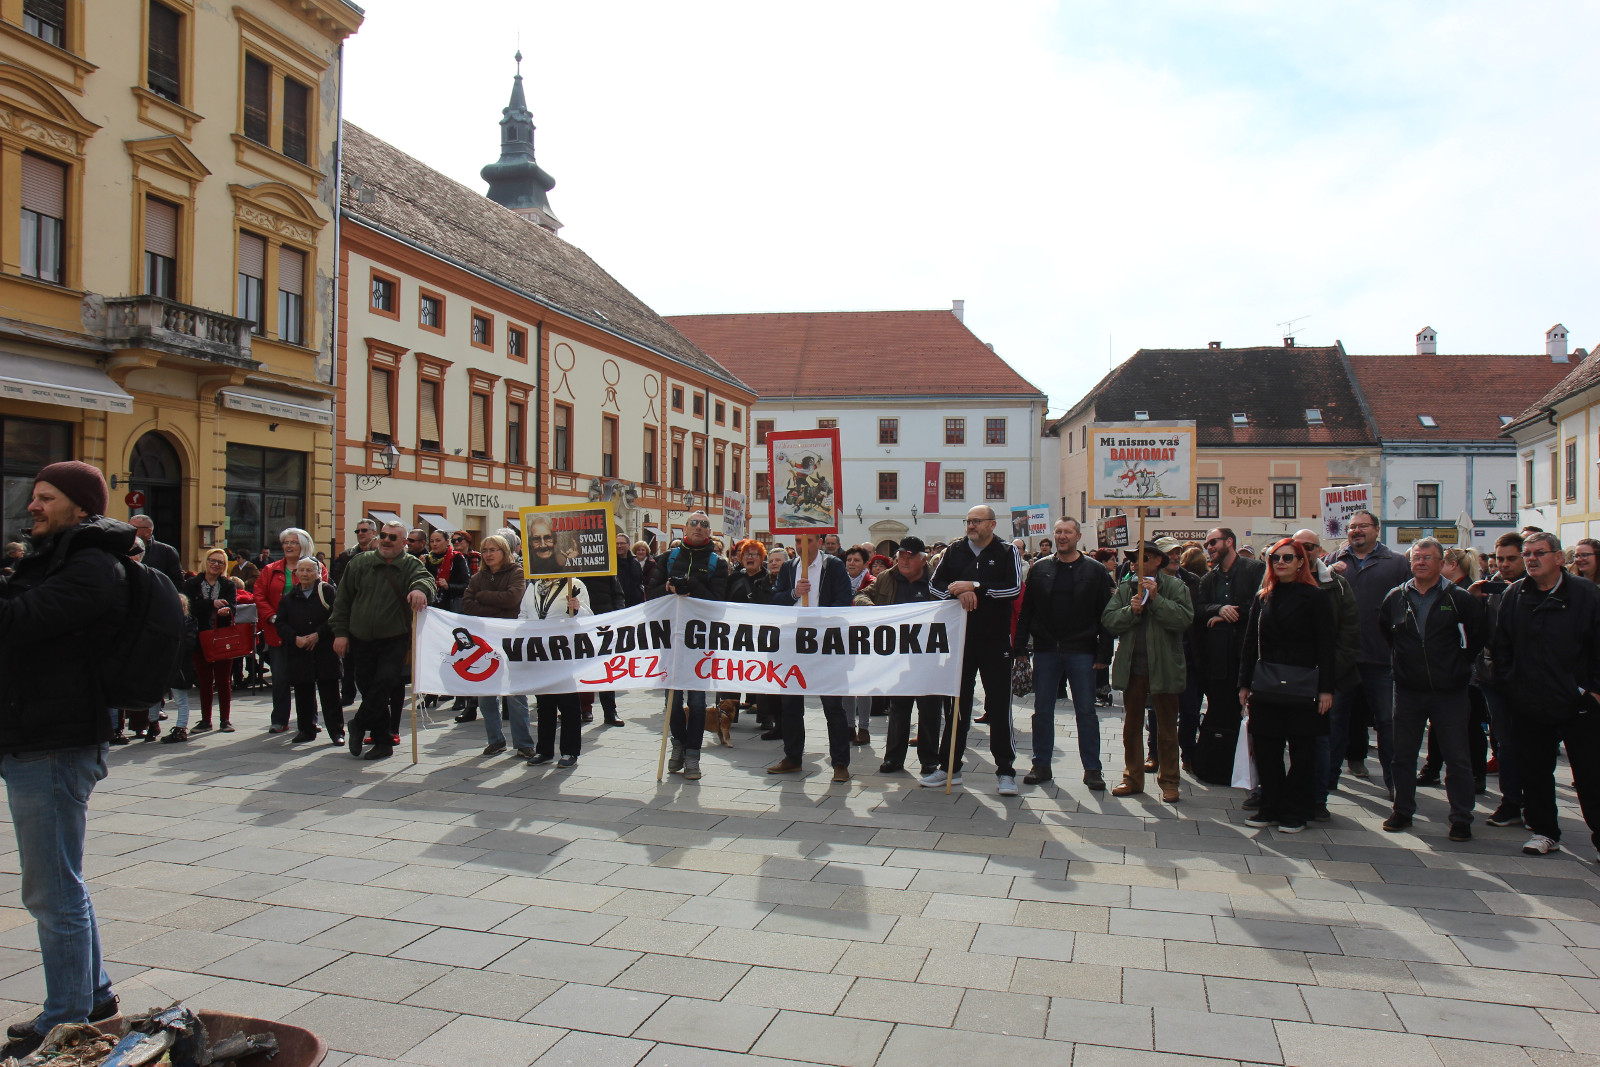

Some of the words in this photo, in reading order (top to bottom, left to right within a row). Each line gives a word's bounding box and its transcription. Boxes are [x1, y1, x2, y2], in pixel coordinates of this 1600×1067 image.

[1100, 437, 1115, 446] Mi
[1118, 437, 1156, 446] nismo
[1110, 448, 1176, 461] BANKOMAT
[452, 492, 500, 508] VARTEKS
[551, 512, 604, 532] ZADUŽITE
[579, 533, 603, 543] SVOJU
[1190, 531, 1207, 539] SHO
[581, 545, 604, 555] MAMU
[565, 557, 571, 567] A
[572, 557, 583, 567] NE
[583, 556, 605, 566] NAS!!!
[502, 619, 672, 662] VARAŽDIN
[684, 619, 781, 653] GRAD
[795, 622, 950, 656] BAROKA
[579, 655, 669, 685] BEZ
